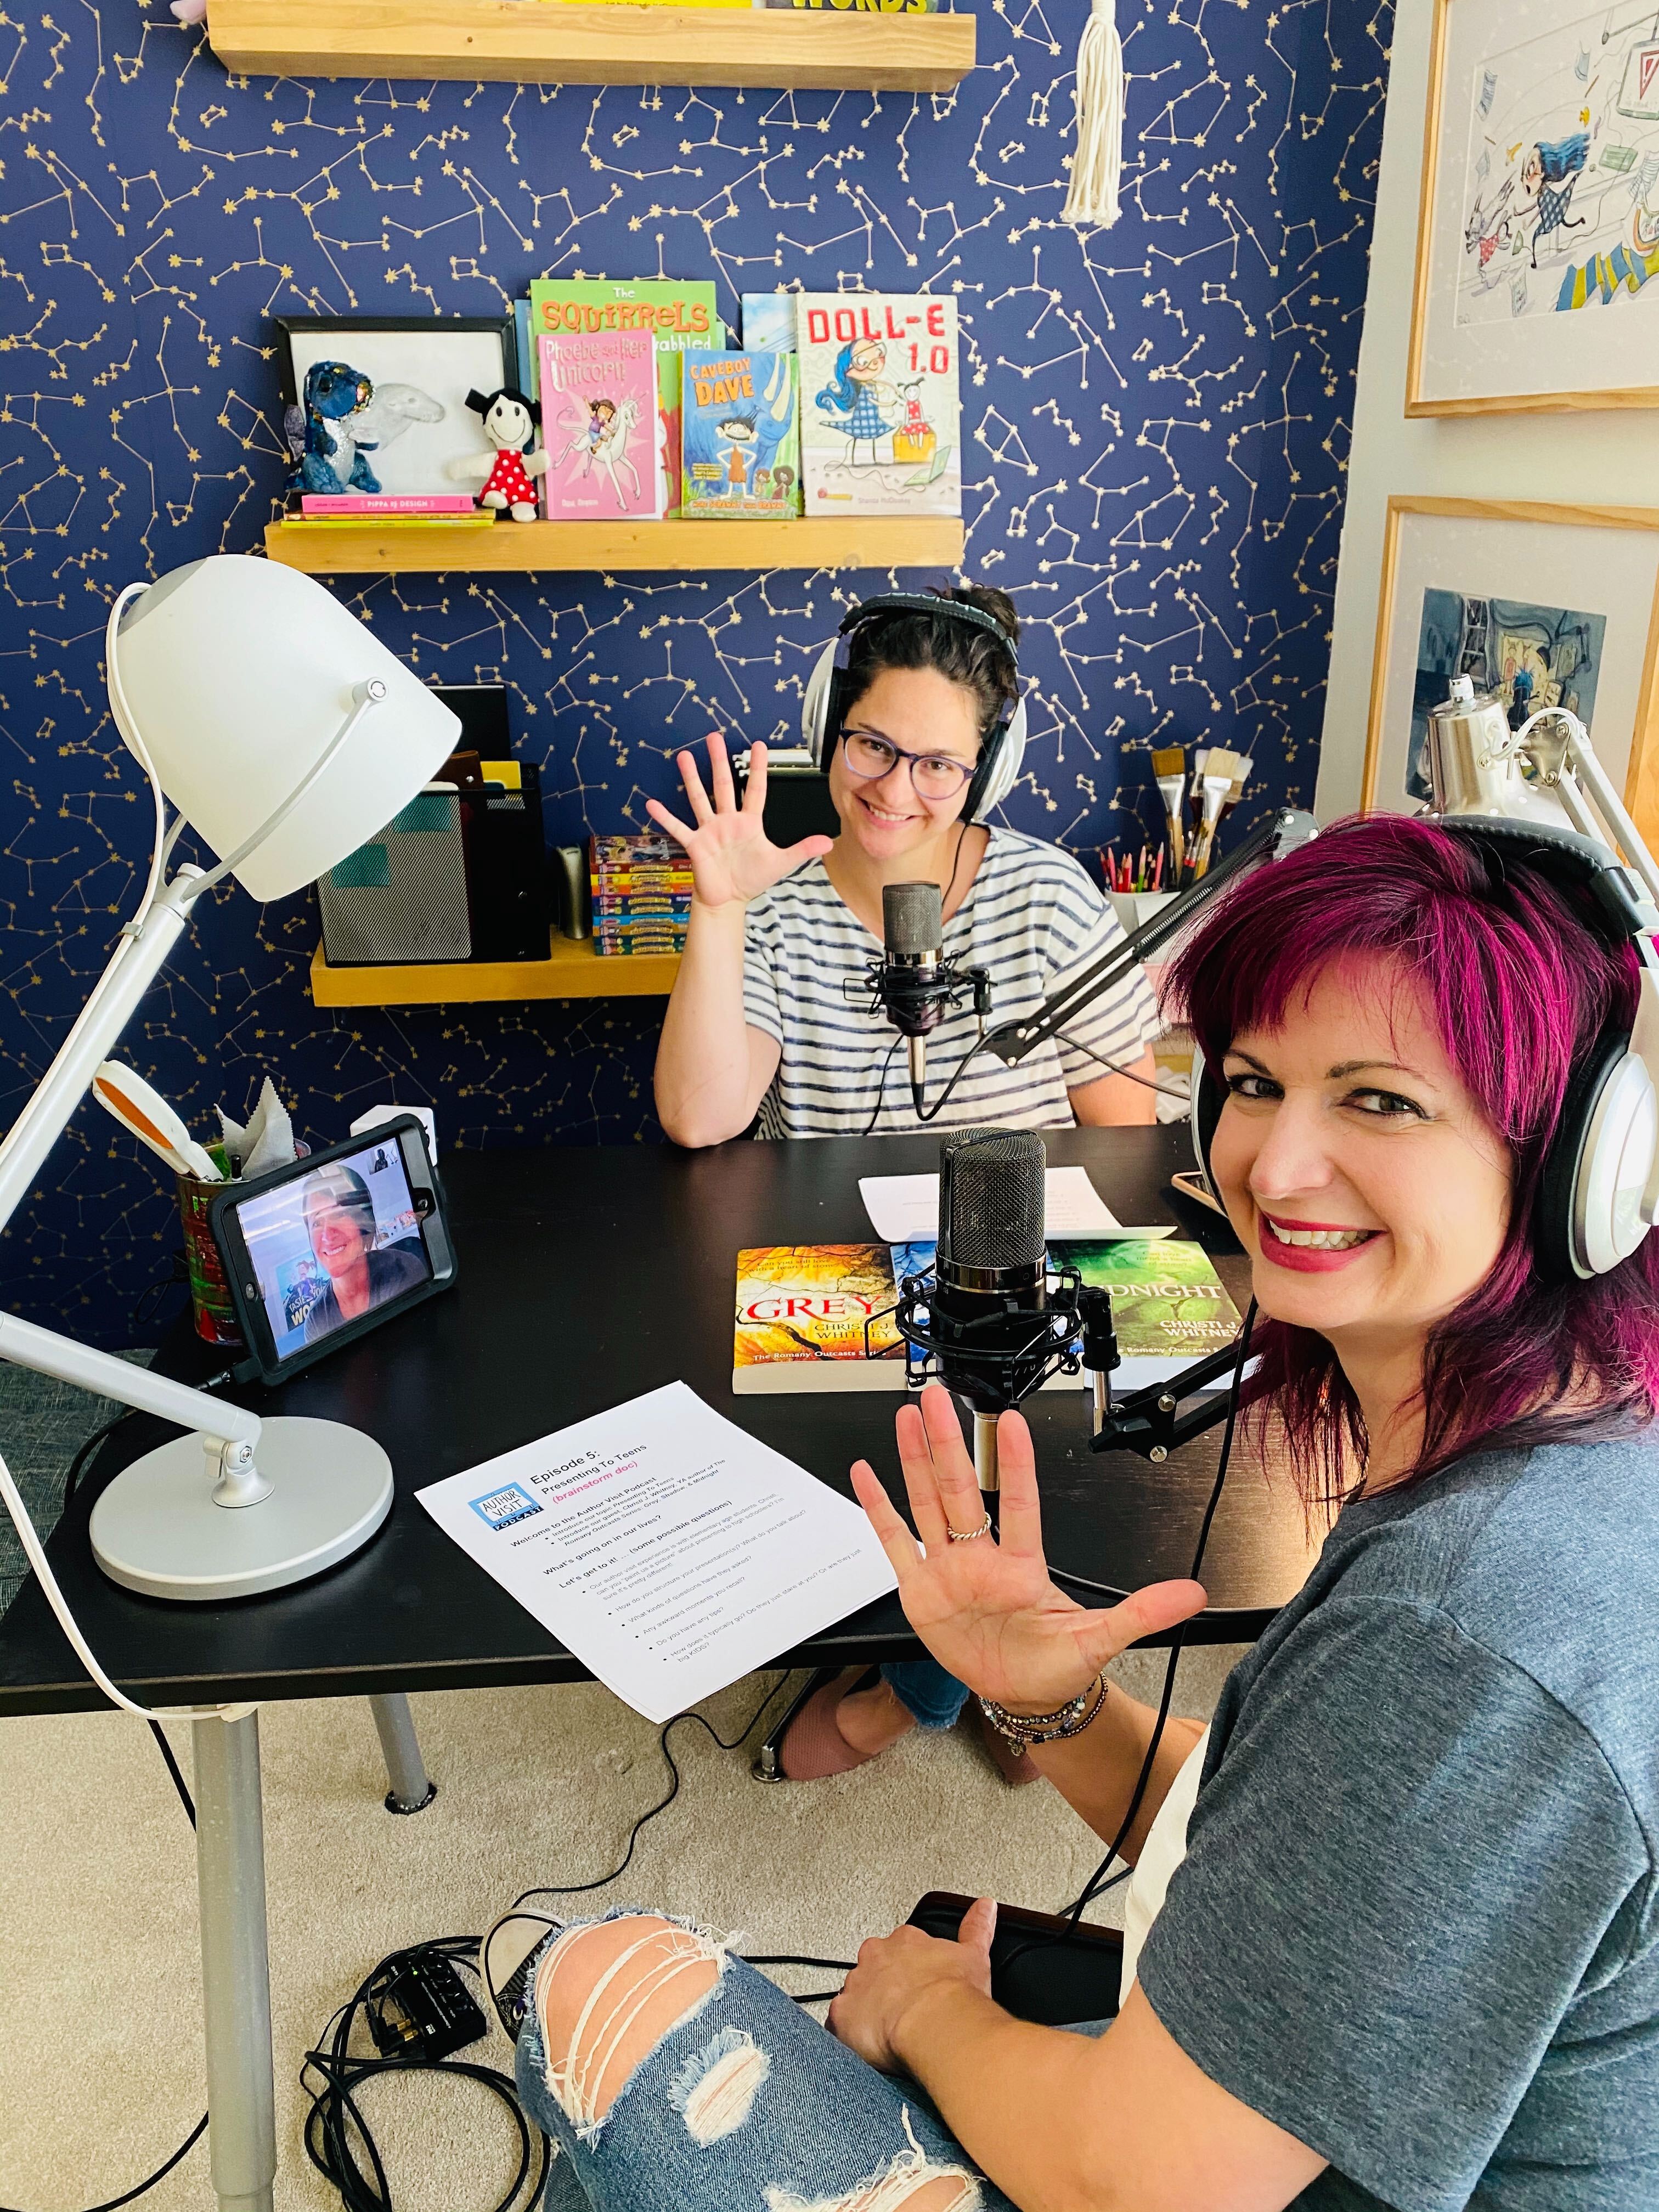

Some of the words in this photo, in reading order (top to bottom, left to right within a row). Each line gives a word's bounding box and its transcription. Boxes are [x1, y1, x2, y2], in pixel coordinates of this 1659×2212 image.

[613, 287, 635, 298] The
[808, 304, 945, 343] DOLL-E
[545, 340, 599, 364] Phoebe
[909, 342, 949, 374] 1.0
[690, 358, 751, 380] CAVEBOY
[695, 374, 755, 406] DAVE
[289, 1295, 306, 1312] TASTE
[747, 1295, 887, 1322] GREY
[816, 1330, 890, 1339] WHITNEY
[1160, 1320, 1223, 1328] CHRISTI
[529, 1457, 585, 1485] Episode
[585, 1451, 601, 1460] 5:
[540, 1466, 601, 1495] Presenting
[597, 1459, 614, 1468] To
[613, 1444, 647, 1460] Teens
[552, 1472, 613, 1504] (brainstorm
[614, 1460, 638, 1475] doc)
[483, 1490, 521, 1512] AUTHOR
[492, 1499, 522, 1516] VISIT
[510, 1527, 551, 1547] Welcome
[561, 1515, 576, 1524] the
[576, 1500, 603, 1517] Author
[603, 1492, 625, 1503] Visit
[623, 1476, 657, 1494] Podcast
[494, 1508, 541, 1531] PODCAST
[542, 1559, 575, 1575] What's
[575, 1545, 601, 1561] going
[600, 1539, 613, 1548] on
[623, 1527, 637, 1536] our
[636, 1514, 662, 1529] lives?
[558, 1575, 582, 1588] Let's
[583, 1567, 599, 1578] get
[608, 1556, 618, 1565] it!
[628, 1538, 656, 1554] (some
[656, 1521, 690, 1541] possible
[690, 1500, 732, 1522] questions)
